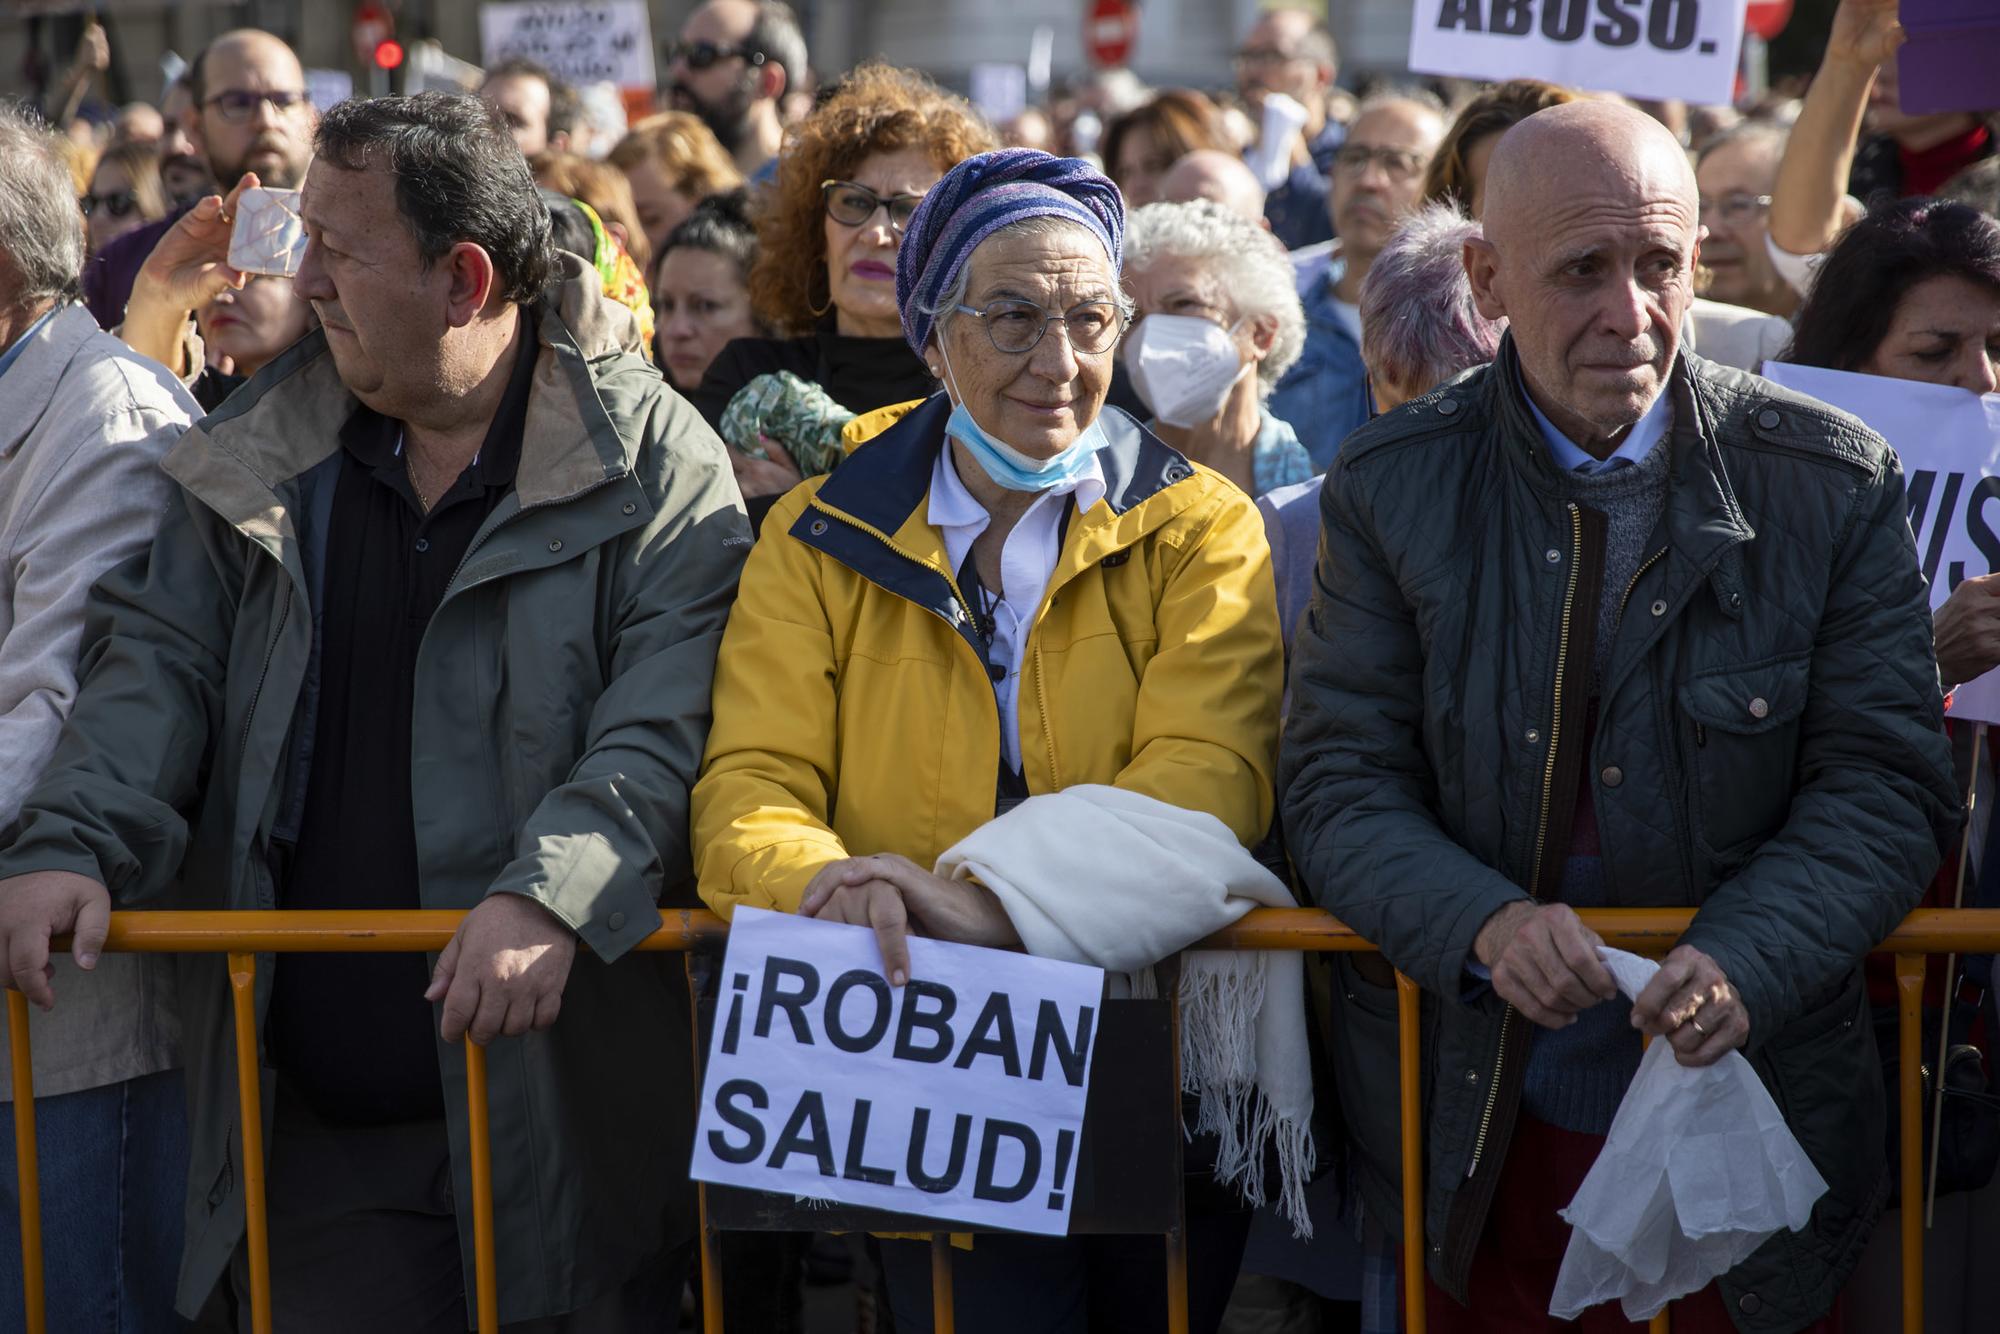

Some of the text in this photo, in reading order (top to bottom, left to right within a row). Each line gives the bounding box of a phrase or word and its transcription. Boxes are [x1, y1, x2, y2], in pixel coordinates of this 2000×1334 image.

[1437, 0, 1717, 53] ABUSO.
[720, 955, 1095, 1087] ¡ROBAN
[707, 1078, 1076, 1211] SALUD!
